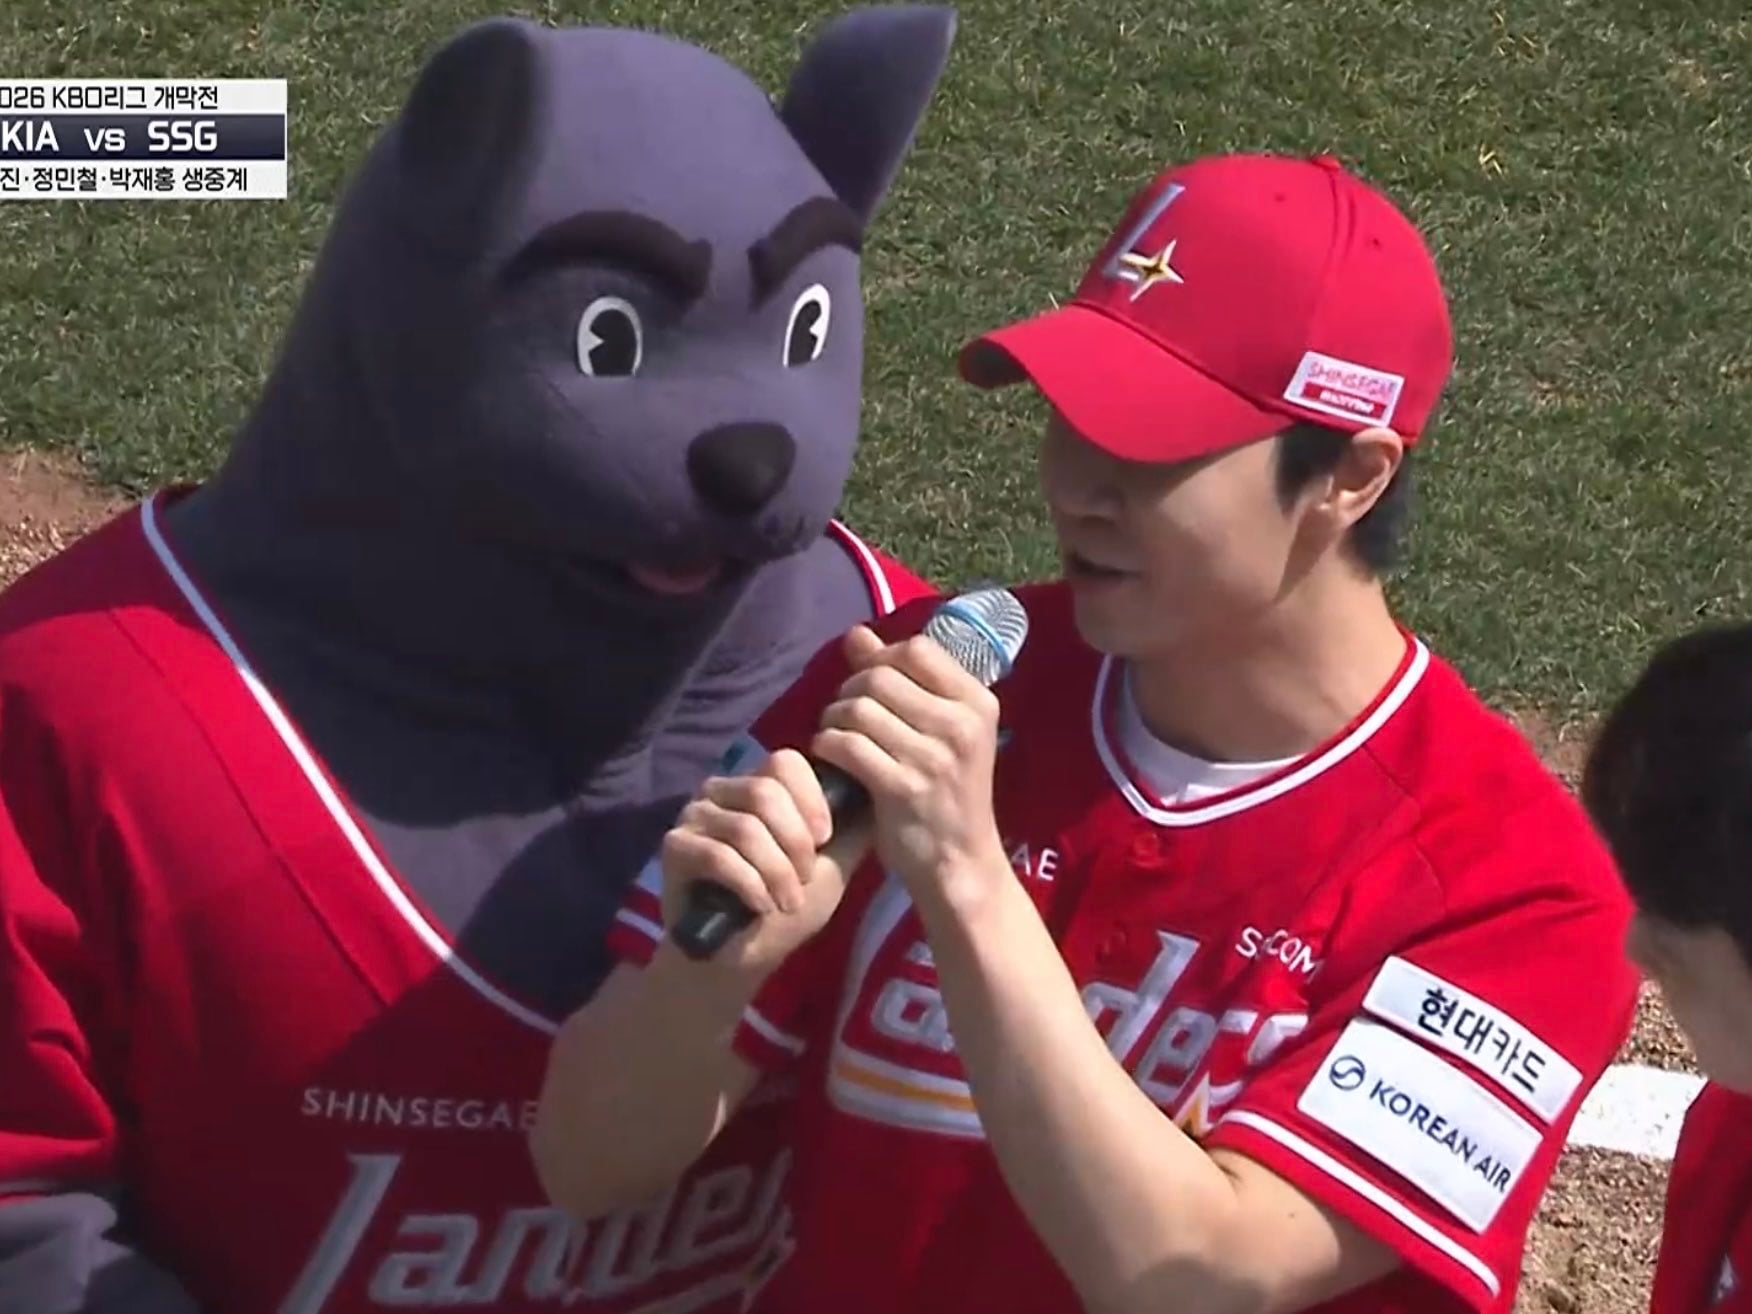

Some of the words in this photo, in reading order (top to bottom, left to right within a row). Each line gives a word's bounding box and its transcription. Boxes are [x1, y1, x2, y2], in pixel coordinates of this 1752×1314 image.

[1235, 926, 1324, 984] SCOM
[1418, 988, 1547, 1094] 현대카드
[301, 1087, 540, 1131] SHINSEGAE
[1369, 1080, 1478, 1163] KOREAN
[1474, 1155, 1512, 1193] AIR
